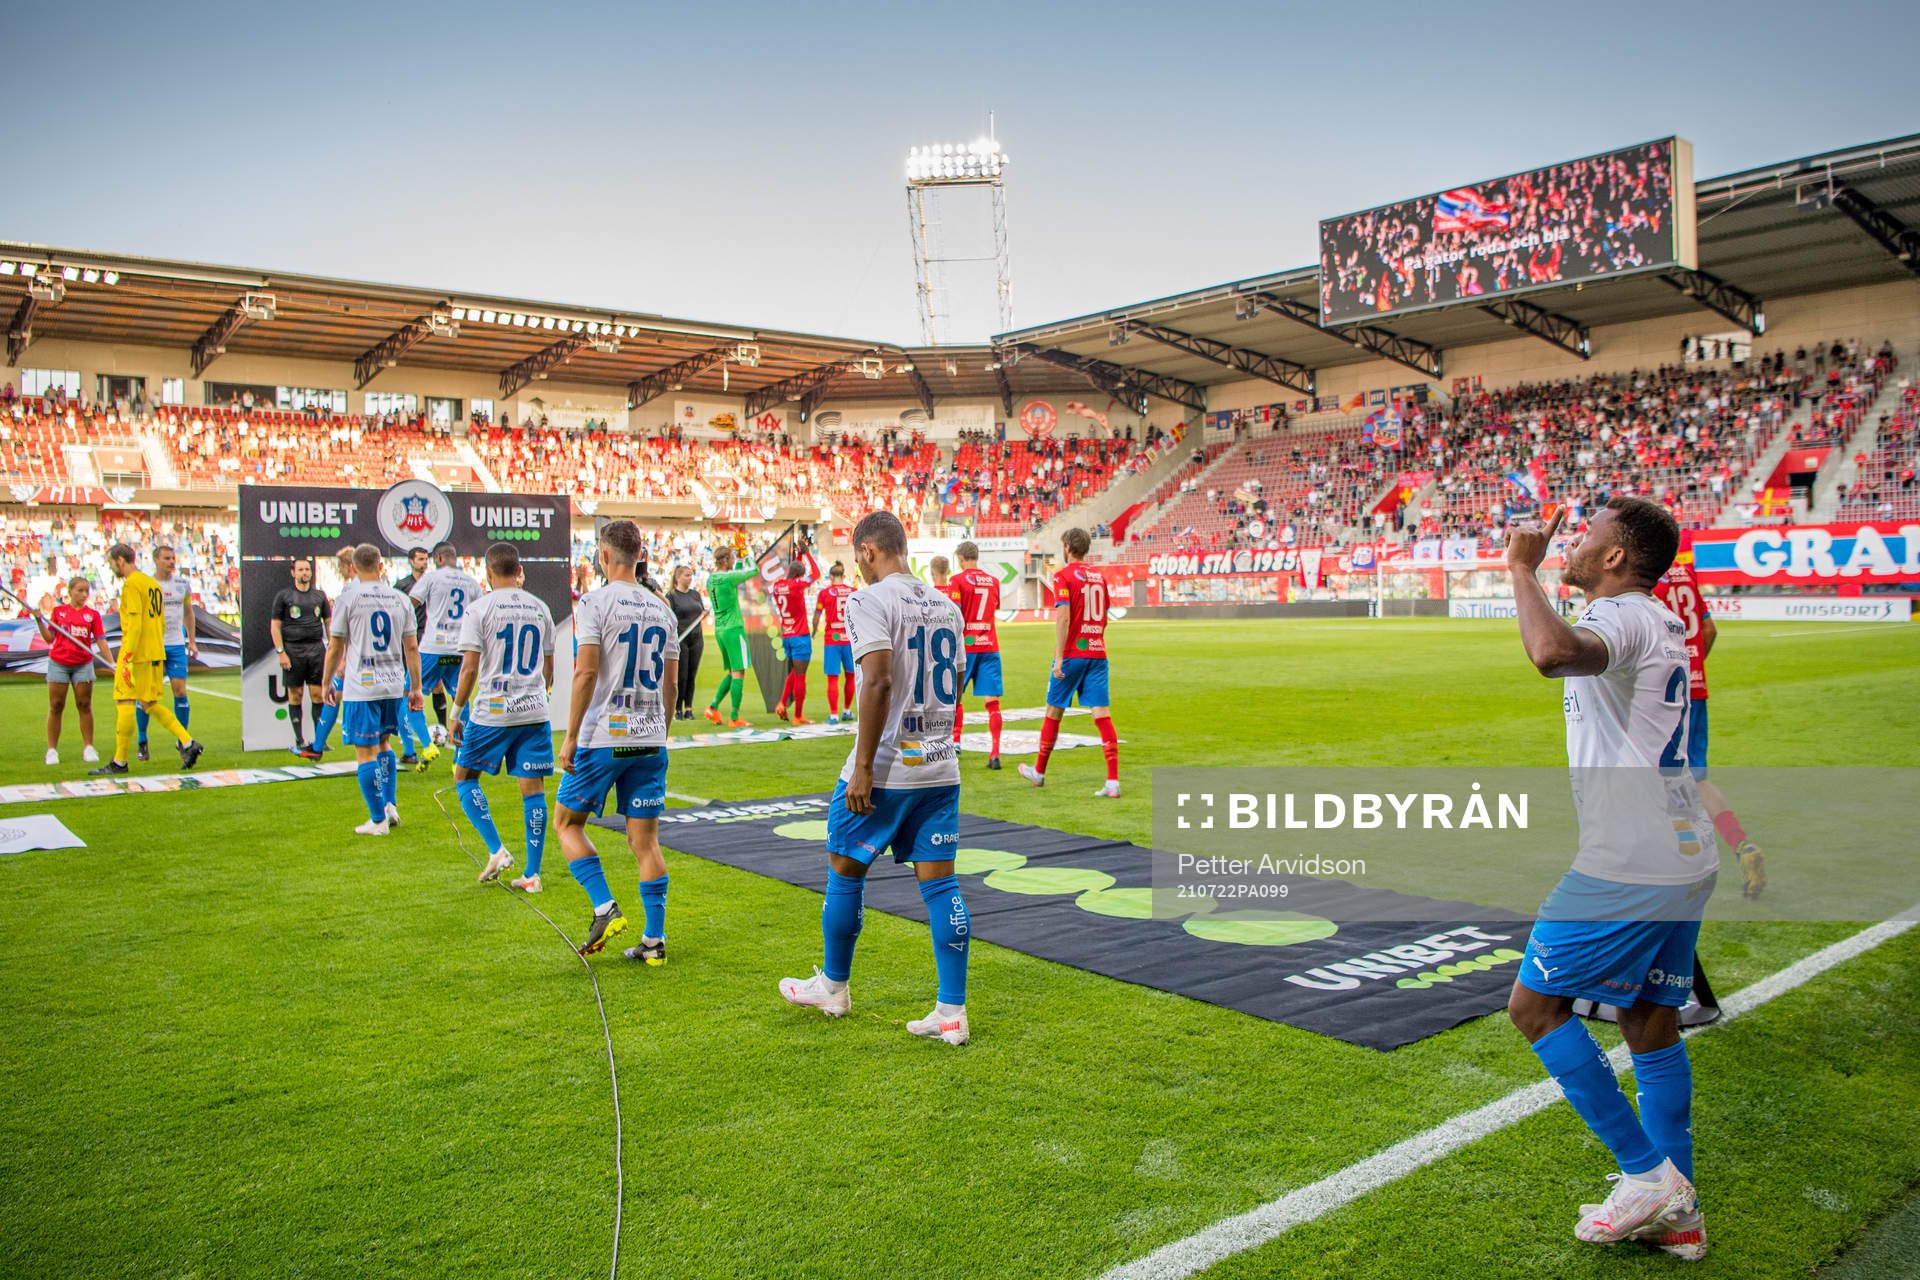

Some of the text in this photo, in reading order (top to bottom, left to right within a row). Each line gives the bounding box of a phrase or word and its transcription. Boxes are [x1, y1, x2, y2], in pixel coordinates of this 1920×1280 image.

[1510, 232, 1540, 250] och
[756, 412, 782, 432] MAX
[259, 500, 358, 525] UNIBET
[470, 505, 555, 529] UNIBET
[1148, 554, 1199, 575] SÖDRA
[1252, 550, 1298, 573] 1985
[148, 587, 163, 618] 30
[447, 587, 465, 620] 3
[778, 595, 791, 618] 2
[836, 597, 846, 621] 5
[974, 588, 989, 621] 7
[1080, 583, 1105, 622] 10
[1666, 584, 1699, 640] 13
[370, 610, 391, 652] 9
[496, 623, 540, 676] 10
[618, 623, 667, 691] 13
[907, 625, 957, 705] 18
[1658, 665, 1688, 778] 2
[530, 808, 543, 847] 4 office
[948, 895, 968, 952] 4 office
[1283, 925, 1512, 991] UNIBET
[1665, 974, 1694, 989] RAVE
